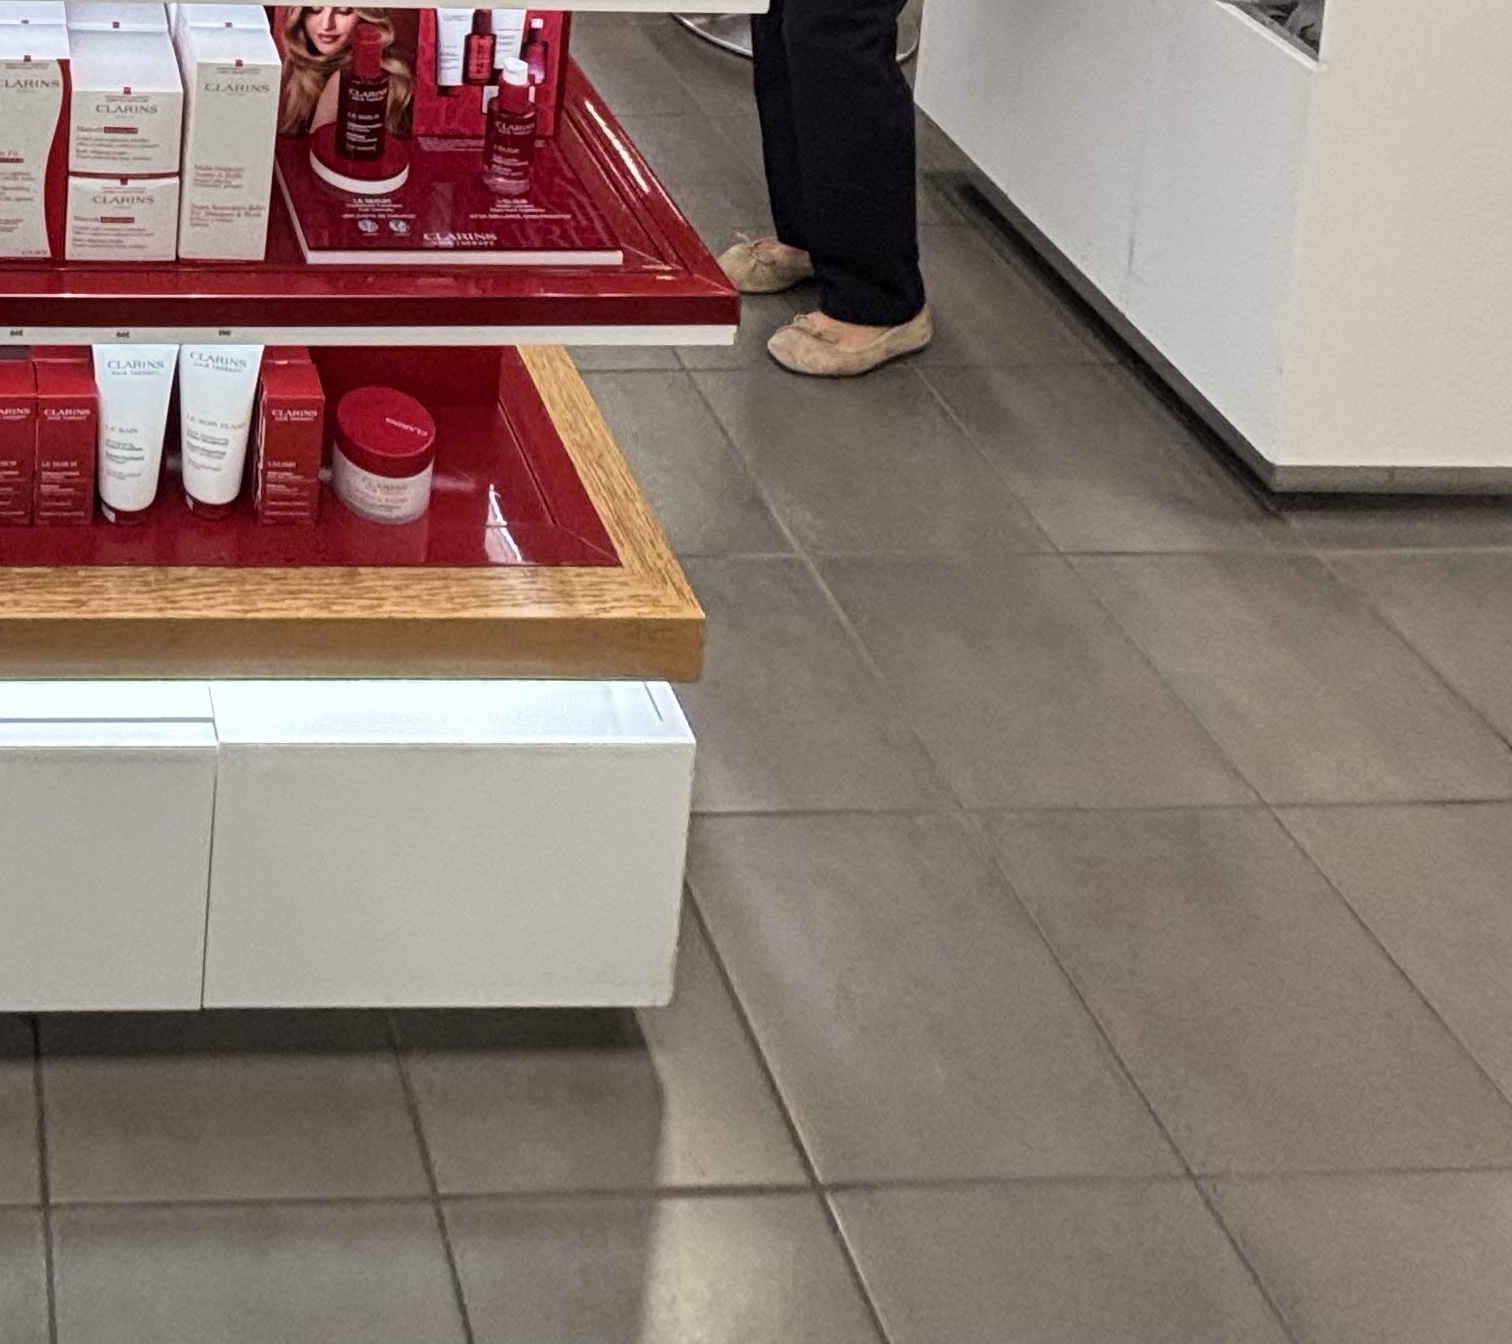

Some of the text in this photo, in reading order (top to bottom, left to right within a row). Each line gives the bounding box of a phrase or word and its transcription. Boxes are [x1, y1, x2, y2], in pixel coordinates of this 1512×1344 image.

[204, 83, 270, 94] CLARINS
[95, 104, 158, 114] CLARINS
[92, 195, 154, 205] CLARINS
[423, 232, 498, 241] CLARINS
[107, 360, 165, 370] CLARINS
[190, 351, 247, 369] CLARINS
